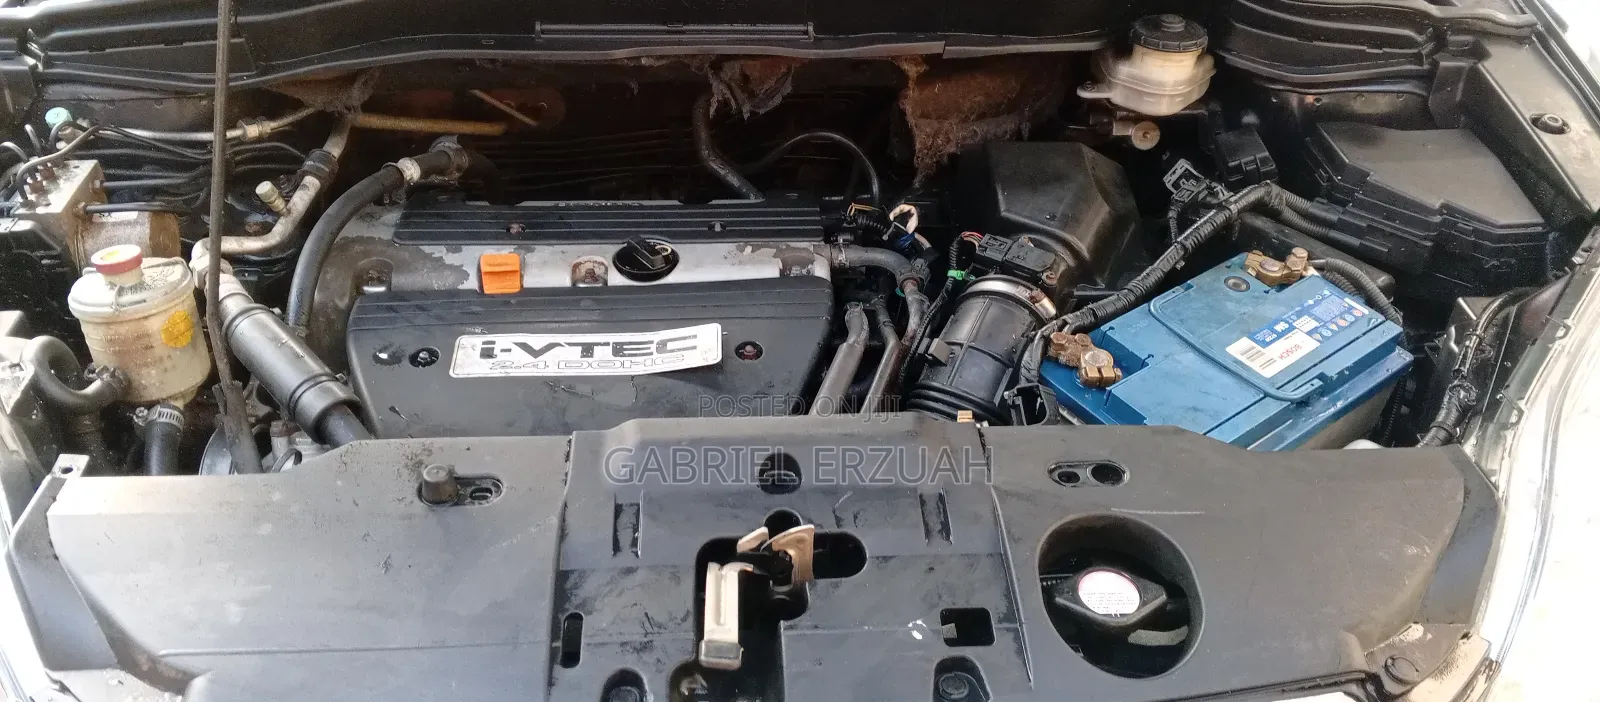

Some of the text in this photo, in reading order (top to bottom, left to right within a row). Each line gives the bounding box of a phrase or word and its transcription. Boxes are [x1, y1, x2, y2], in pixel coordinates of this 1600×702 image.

[479, 334, 697, 359] i-VTEC
[1278, 343, 1302, 360] BOSCH
[489, 354, 685, 370] 2.4 DOHC
